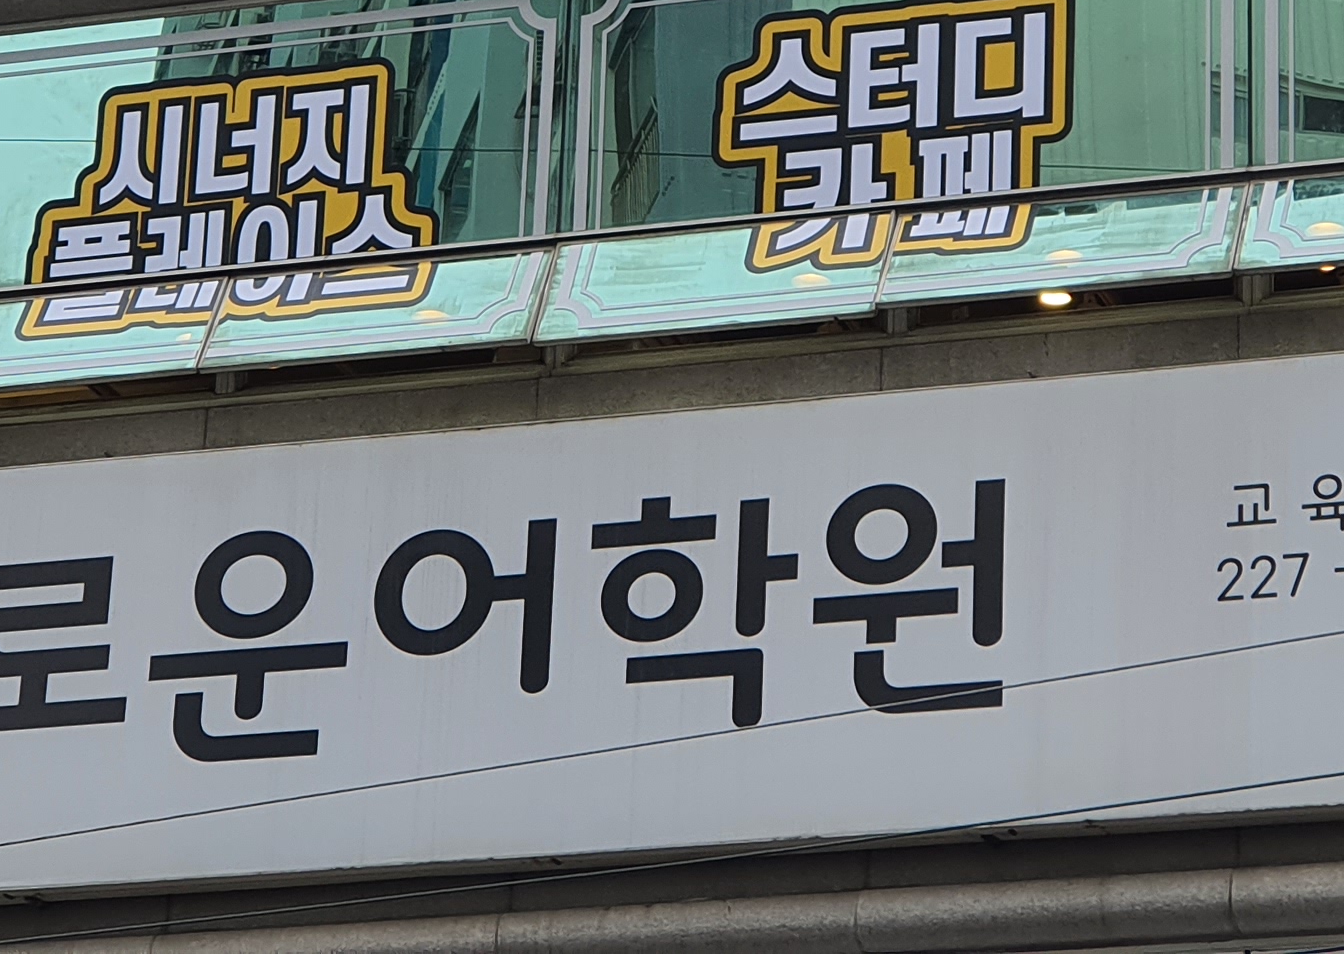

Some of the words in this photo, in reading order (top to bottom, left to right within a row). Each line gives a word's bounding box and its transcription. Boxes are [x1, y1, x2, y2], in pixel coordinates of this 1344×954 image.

[739, 12, 1047, 142] 스터디
[99, 84, 369, 207] 시너지
[776, 130, 1012, 252] 카페
[42, 194, 414, 323] 플레이스
